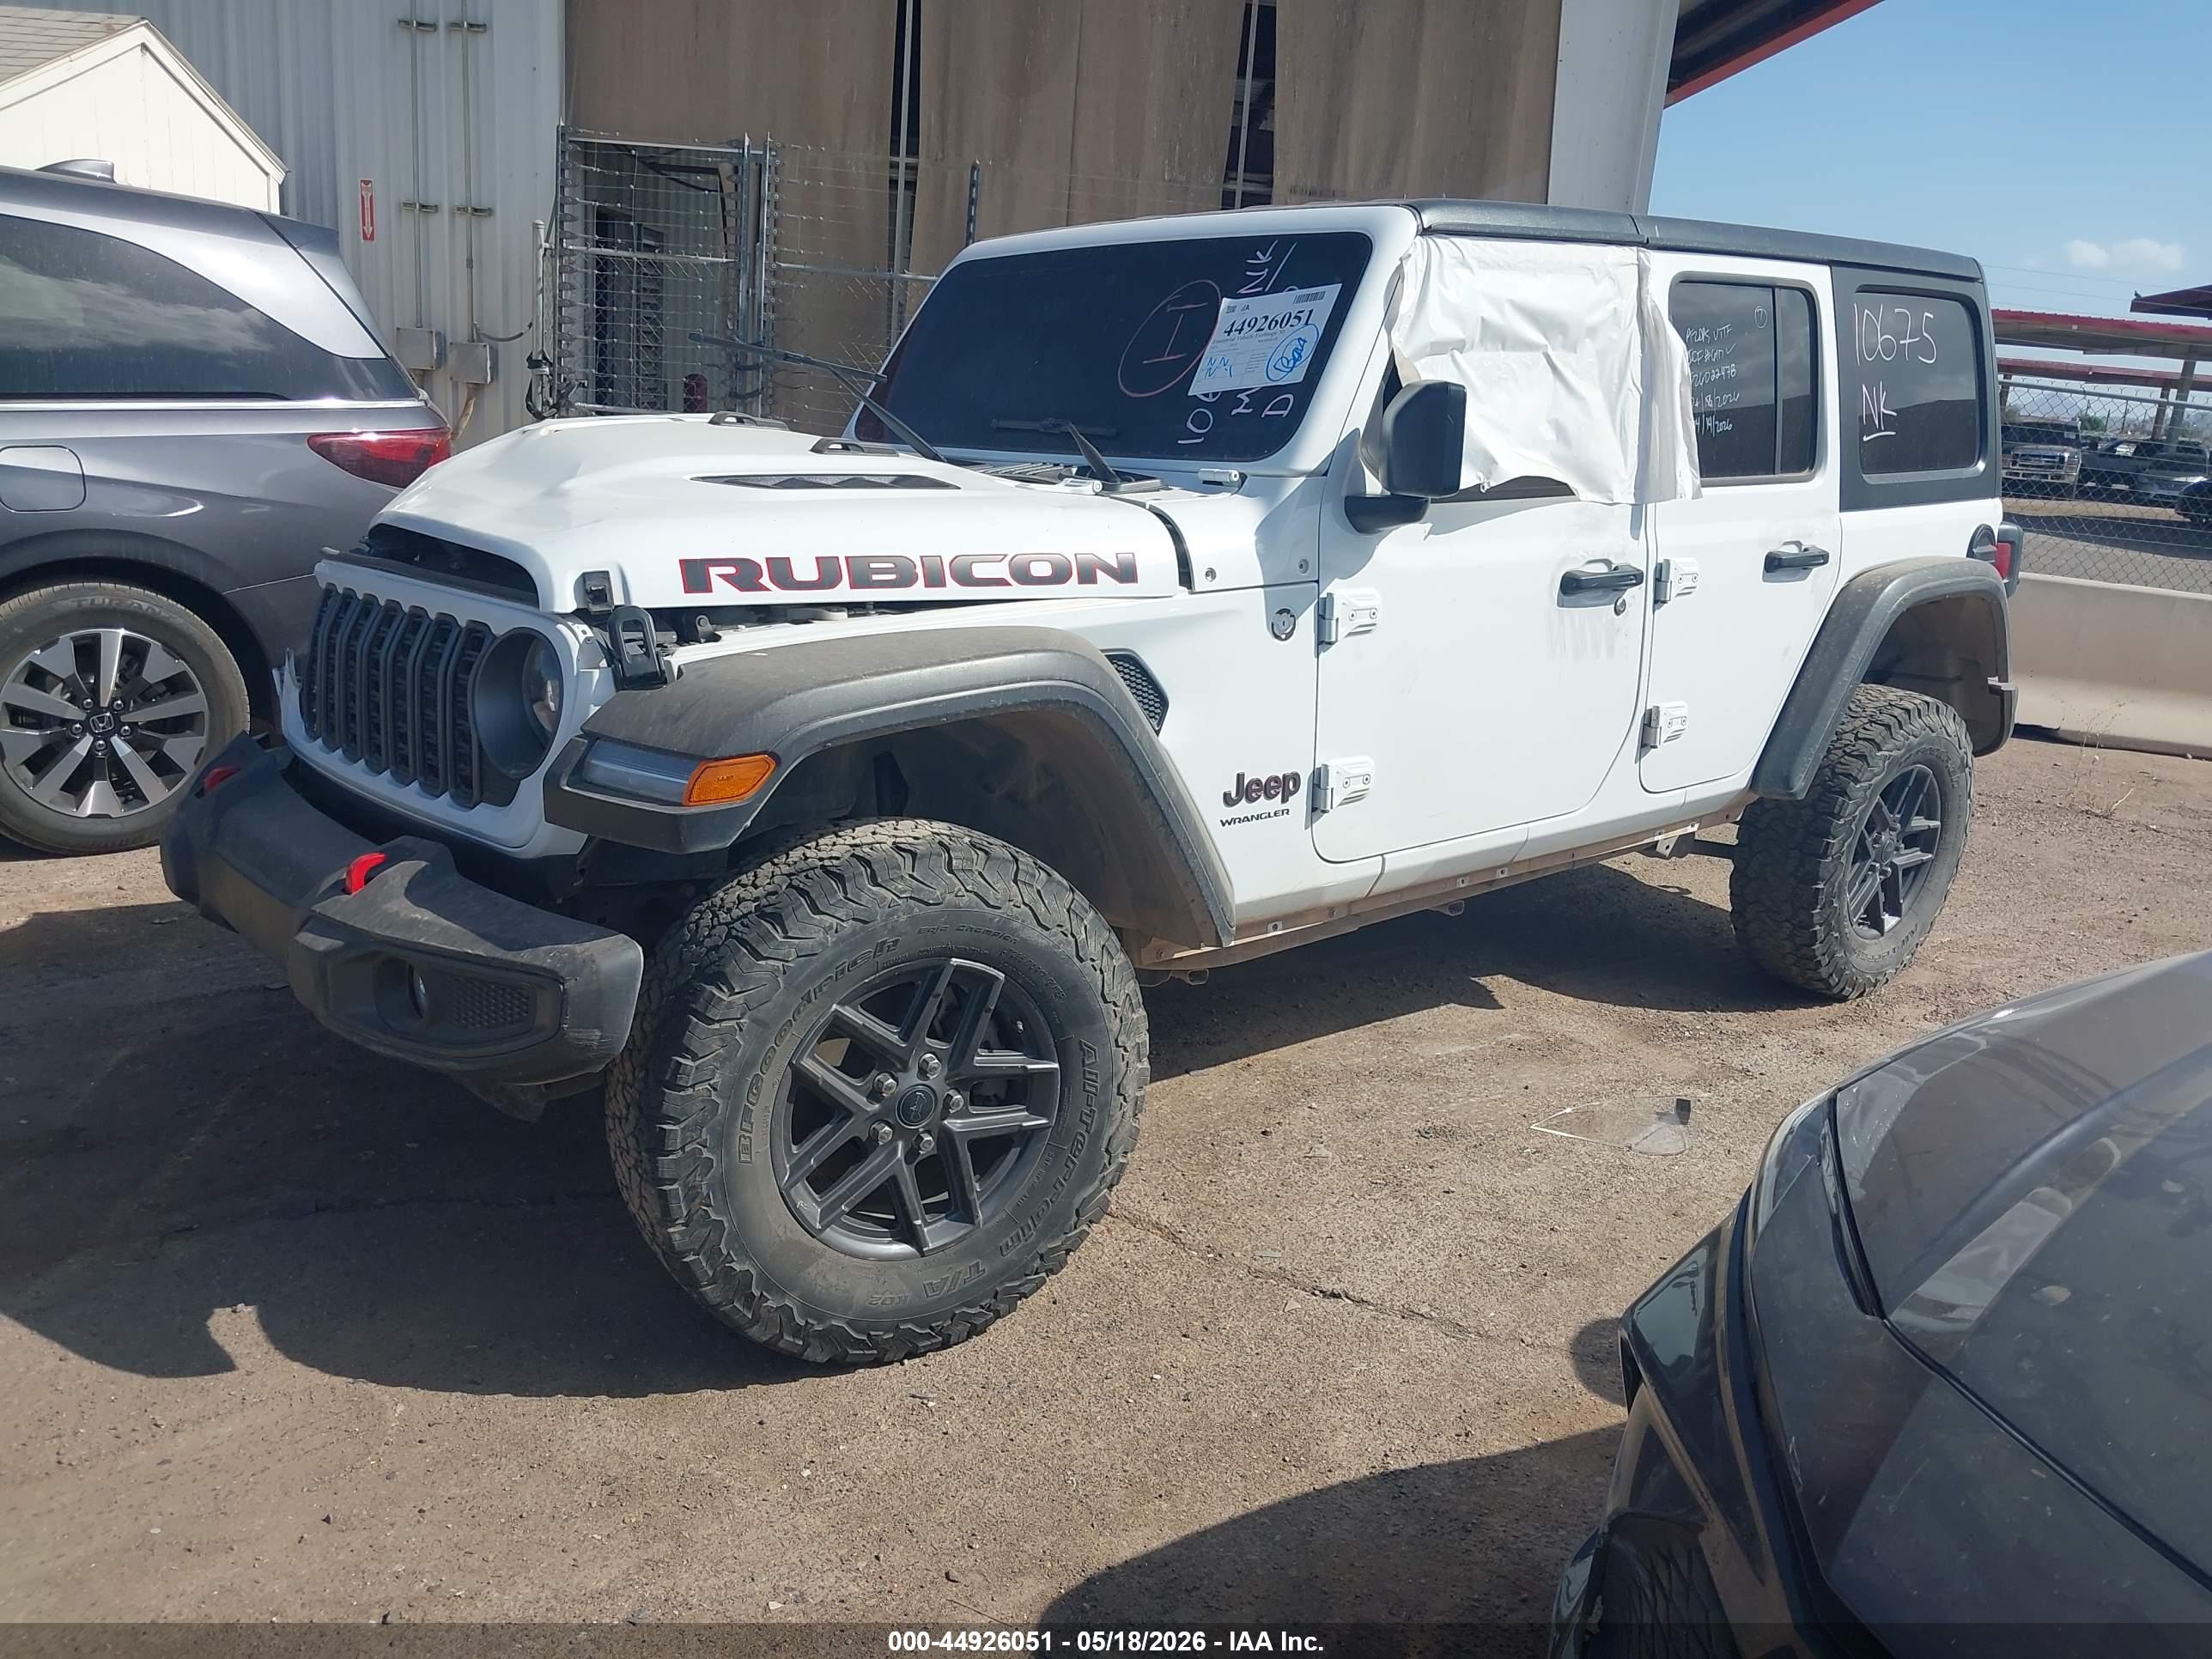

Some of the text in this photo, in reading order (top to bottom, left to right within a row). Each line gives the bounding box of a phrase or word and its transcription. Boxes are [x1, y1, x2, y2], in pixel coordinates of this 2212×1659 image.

[1223, 308, 1315, 337] 44926051
[1854, 303, 1938, 367] 10675
[1862, 380, 1898, 431] NK
[678, 551, 1139, 594] RUBICON
[1223, 771, 1302, 808] Jeep
[1219, 808, 1291, 828] WRANGLER
[954, 923, 1021, 945] Champion
[738, 937, 902, 1164] BFGoodrich
[999, 1038, 1100, 1258] All-Terrain
[921, 1258, 988, 1299] T/A
